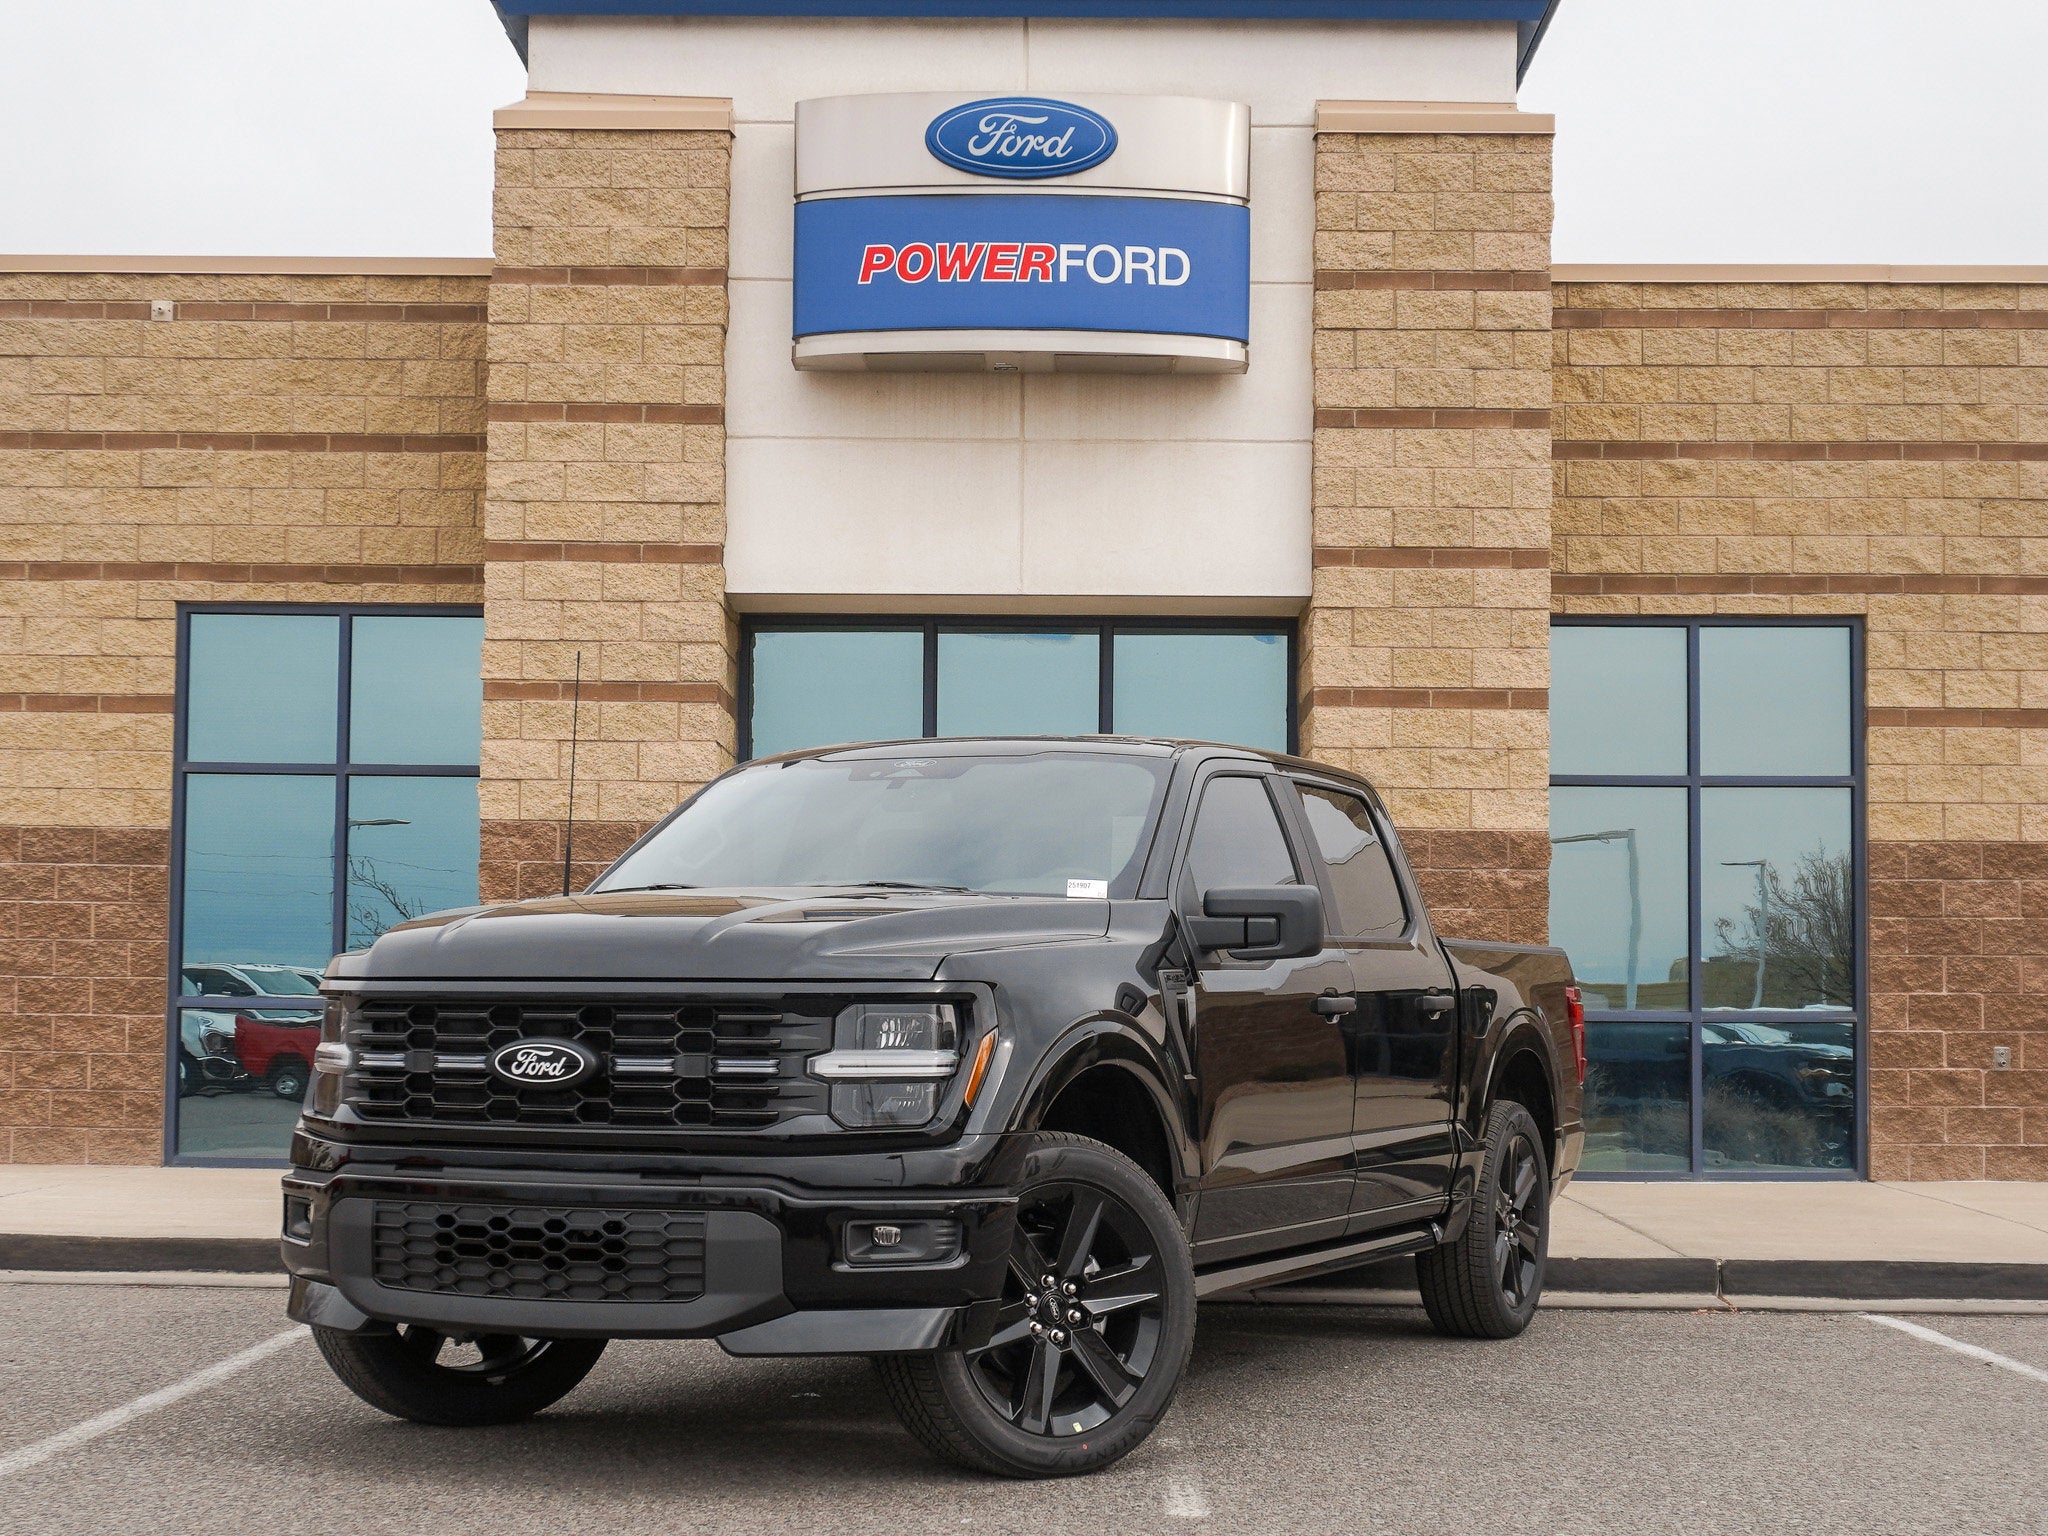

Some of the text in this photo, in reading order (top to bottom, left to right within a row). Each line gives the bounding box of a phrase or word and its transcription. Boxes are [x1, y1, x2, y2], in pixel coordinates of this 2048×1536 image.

[968, 112, 1073, 158] Ford
[858, 242, 1191, 287] POWERFORD
[511, 1048, 567, 1076] Ford
